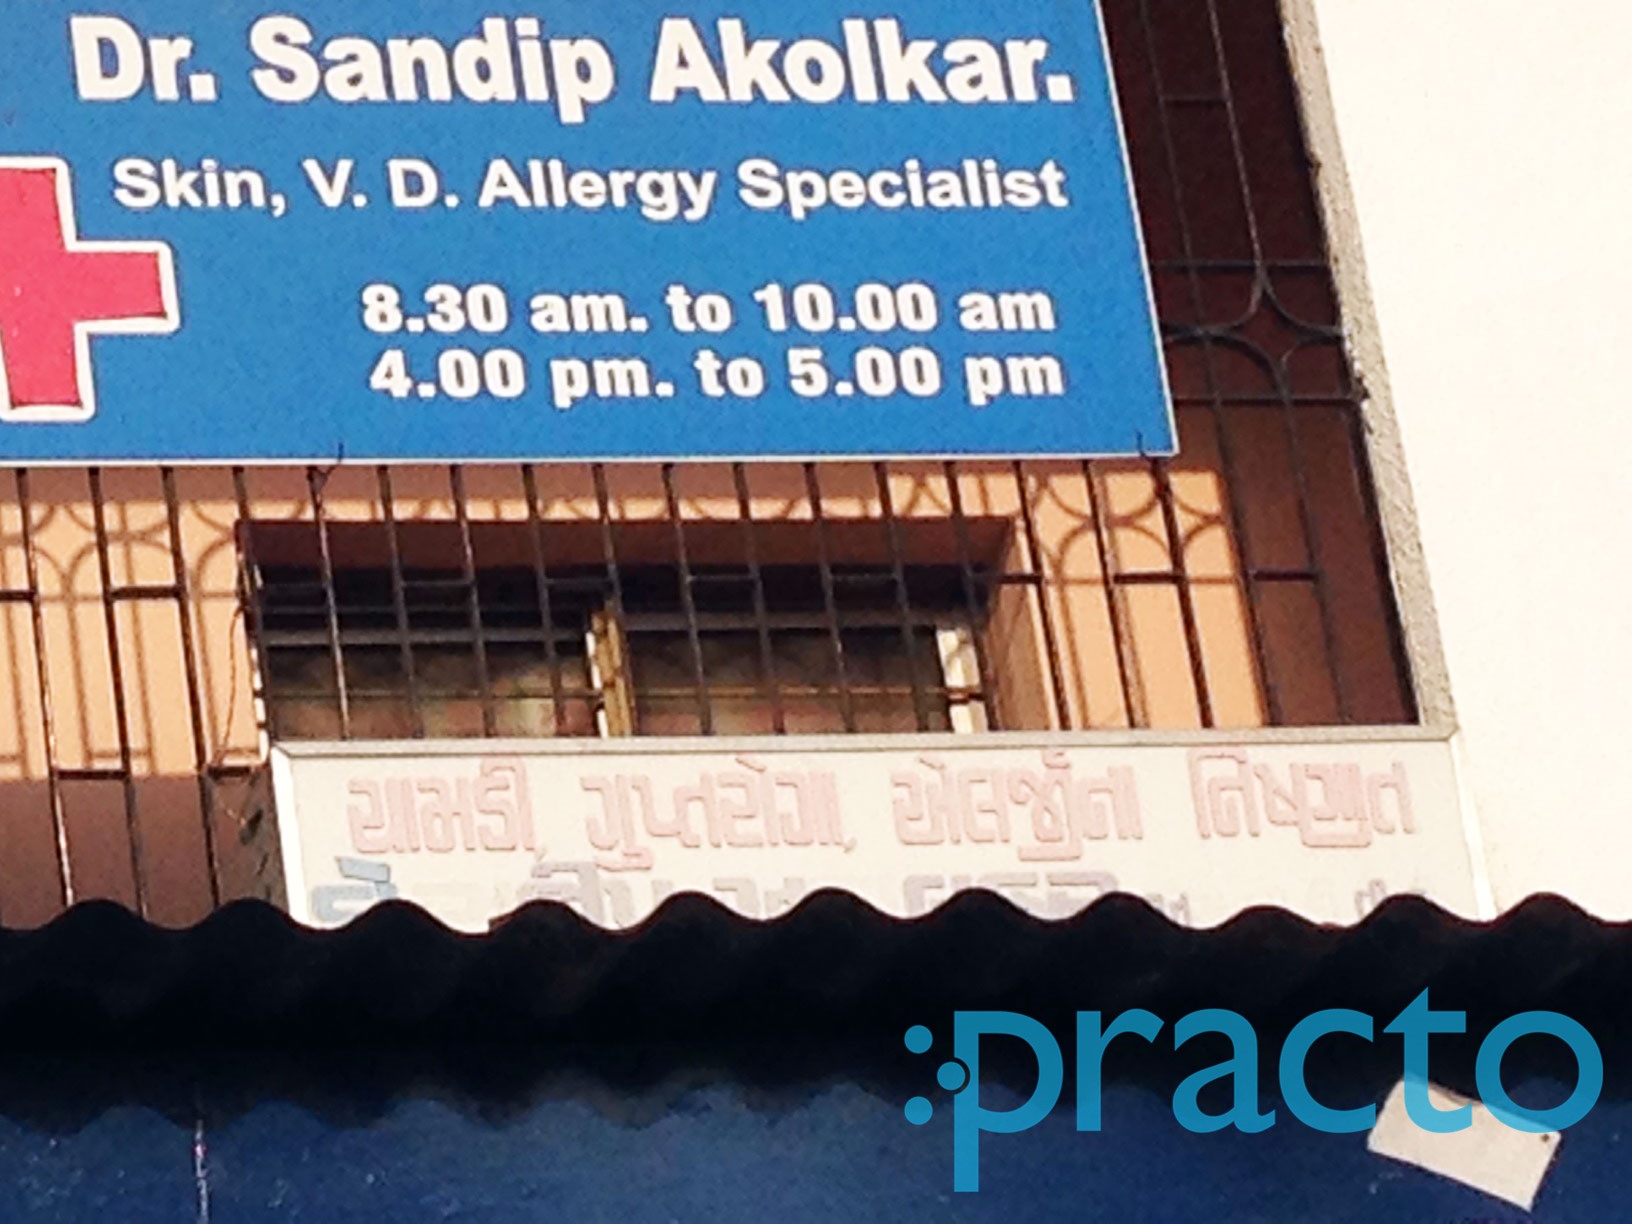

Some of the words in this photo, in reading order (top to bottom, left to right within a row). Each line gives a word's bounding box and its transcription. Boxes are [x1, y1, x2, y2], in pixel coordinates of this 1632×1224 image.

[70, 16, 216, 101] Dr.
[251, 15, 614, 123] Sandip
[650, 18, 1073, 103] Akolkar.
[114, 159, 285, 216] Skin,
[303, 159, 366, 207] V.
[388, 159, 458, 207] D.
[479, 159, 716, 220] Allergy
[738, 159, 1068, 219] Specialist
[363, 284, 507, 333] 8.30
[531, 295, 648, 332] am.
[666, 286, 731, 332] to
[754, 283, 937, 331] 10.00
[959, 292, 1055, 330] am
[370, 349, 525, 398] 4.00
[551, 359, 673, 408] pm.
[694, 350, 763, 397] to
[788, 347, 940, 396] 5.00
[965, 356, 1063, 405] pm
